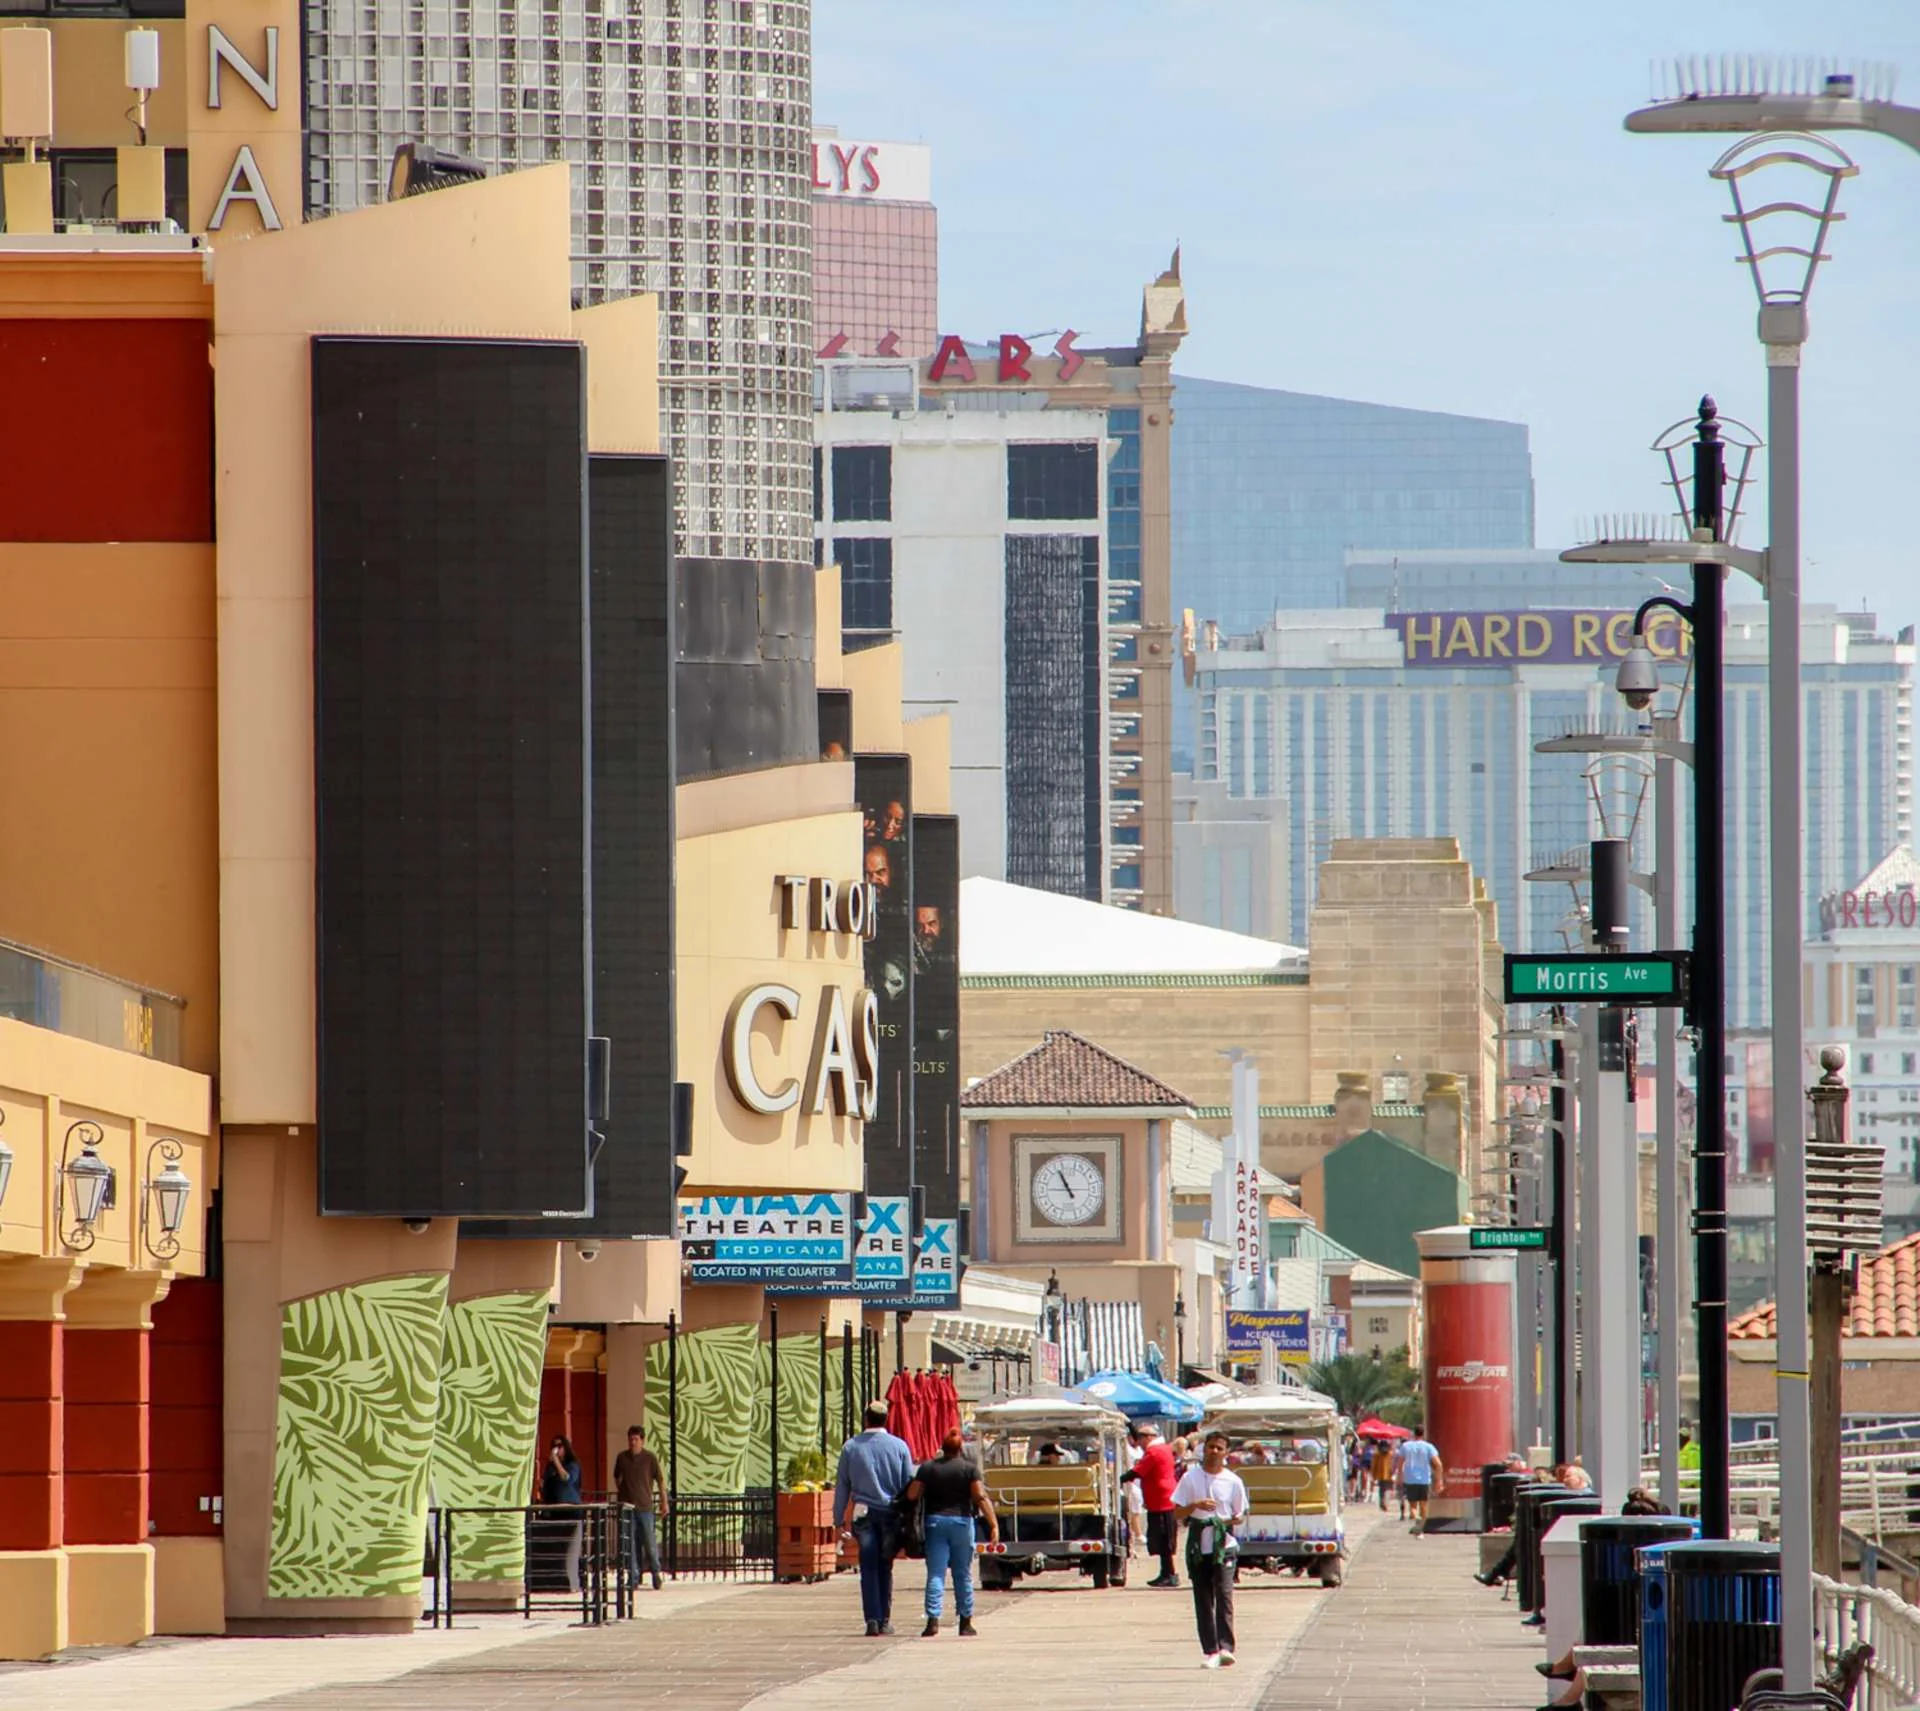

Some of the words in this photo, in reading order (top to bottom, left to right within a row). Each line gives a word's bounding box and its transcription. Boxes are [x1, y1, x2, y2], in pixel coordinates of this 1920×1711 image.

[811, 143, 880, 192] LYS
[1406, 614, 1552, 659] HARD
[1536, 966, 1609, 990] Morris
[1624, 966, 1648, 980] Ave
[722, 982, 878, 1121] CAS
[1236, 1161, 1246, 1271] ARCADE
[1249, 1169, 1260, 1276] ARCADE
[685, 1245, 712, 1256] AT
[720, 1245, 839, 1256] TROPICANA
[692, 1266, 747, 1278] LOCATED
[749, 1267, 762, 1277] IN
[764, 1266, 785, 1277] THE
[787, 1266, 837, 1279] QUARTER
[852, 1280, 897, 1291] QUARTER
